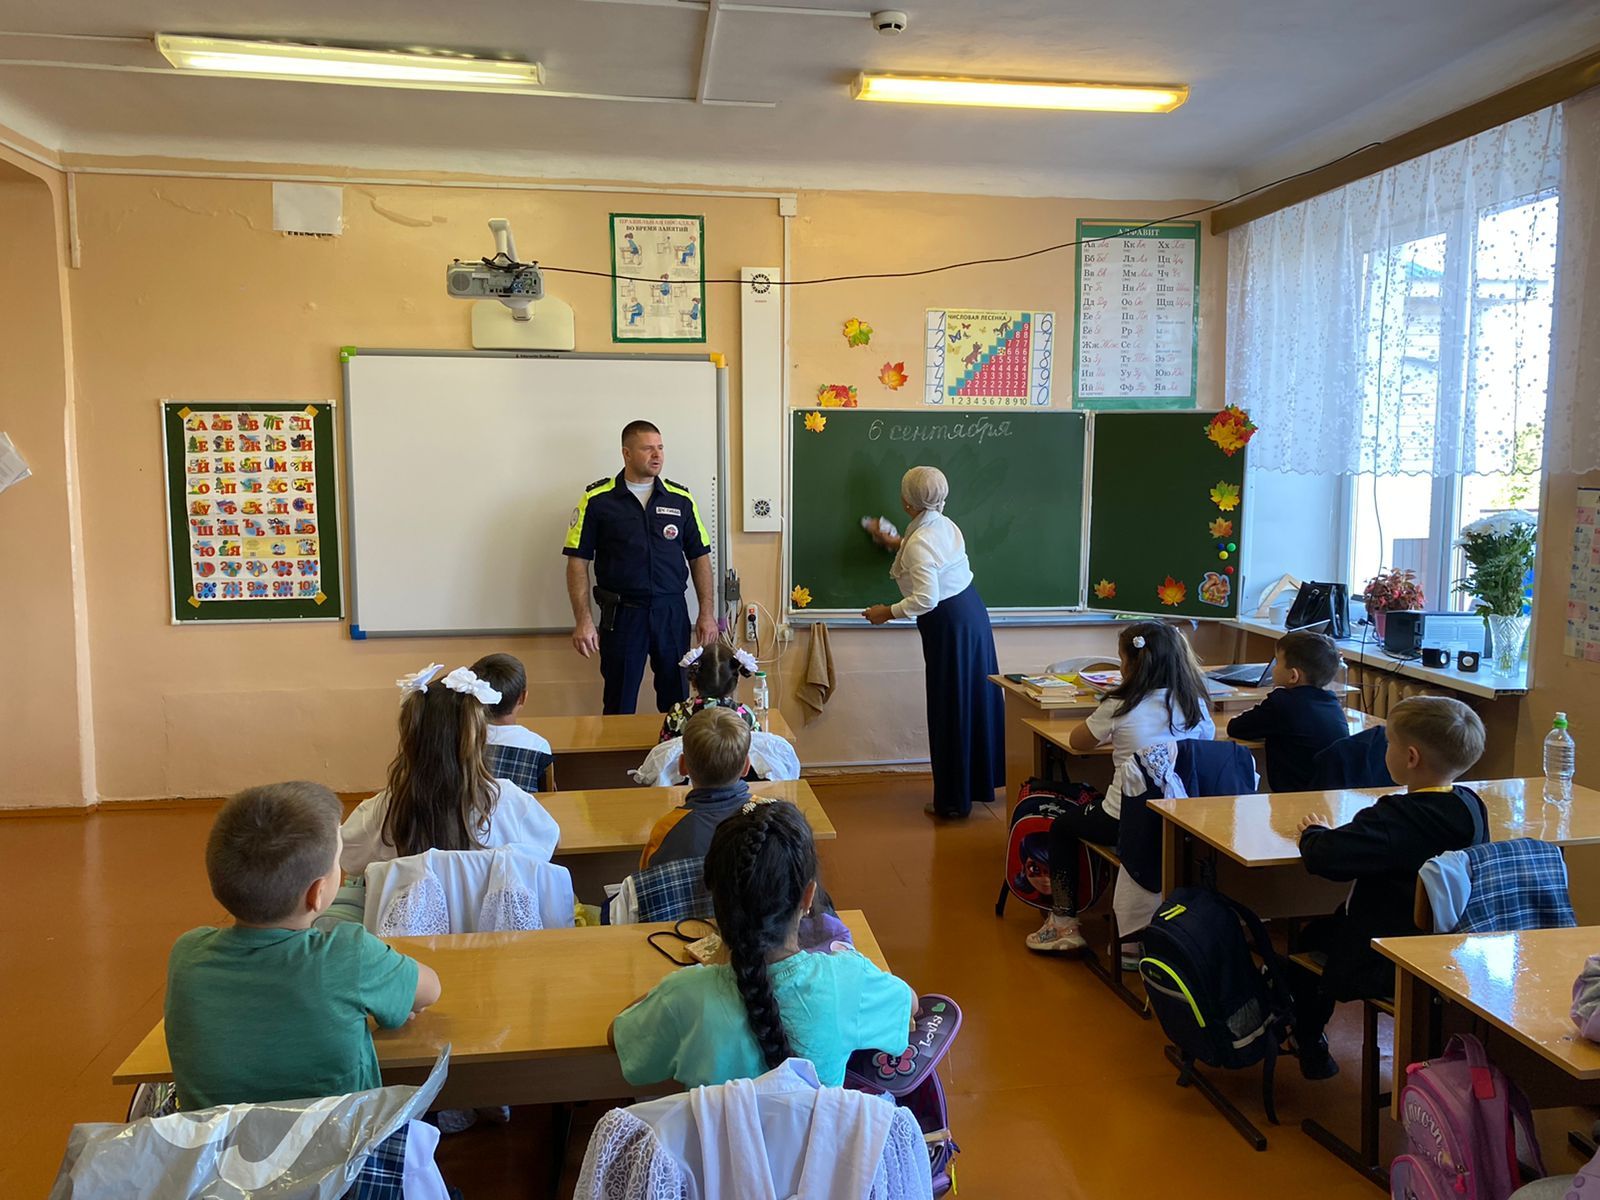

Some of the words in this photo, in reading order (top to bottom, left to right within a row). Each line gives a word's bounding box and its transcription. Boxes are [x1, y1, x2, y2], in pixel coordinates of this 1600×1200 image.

[869, 420, 884, 440] 6
[890, 416, 1012, 444] сентября
[194, 562, 200, 570] 1
[220, 561, 228, 570] 2
[246, 561, 253, 570] 3
[272, 561, 279, 570] 4
[297, 560, 305, 570] 5
[195, 582, 203, 592] 6
[221, 582, 228, 591] 7
[247, 581, 255, 591] 8
[272, 581, 280, 590] 9
[298, 581, 310, 590] 10
